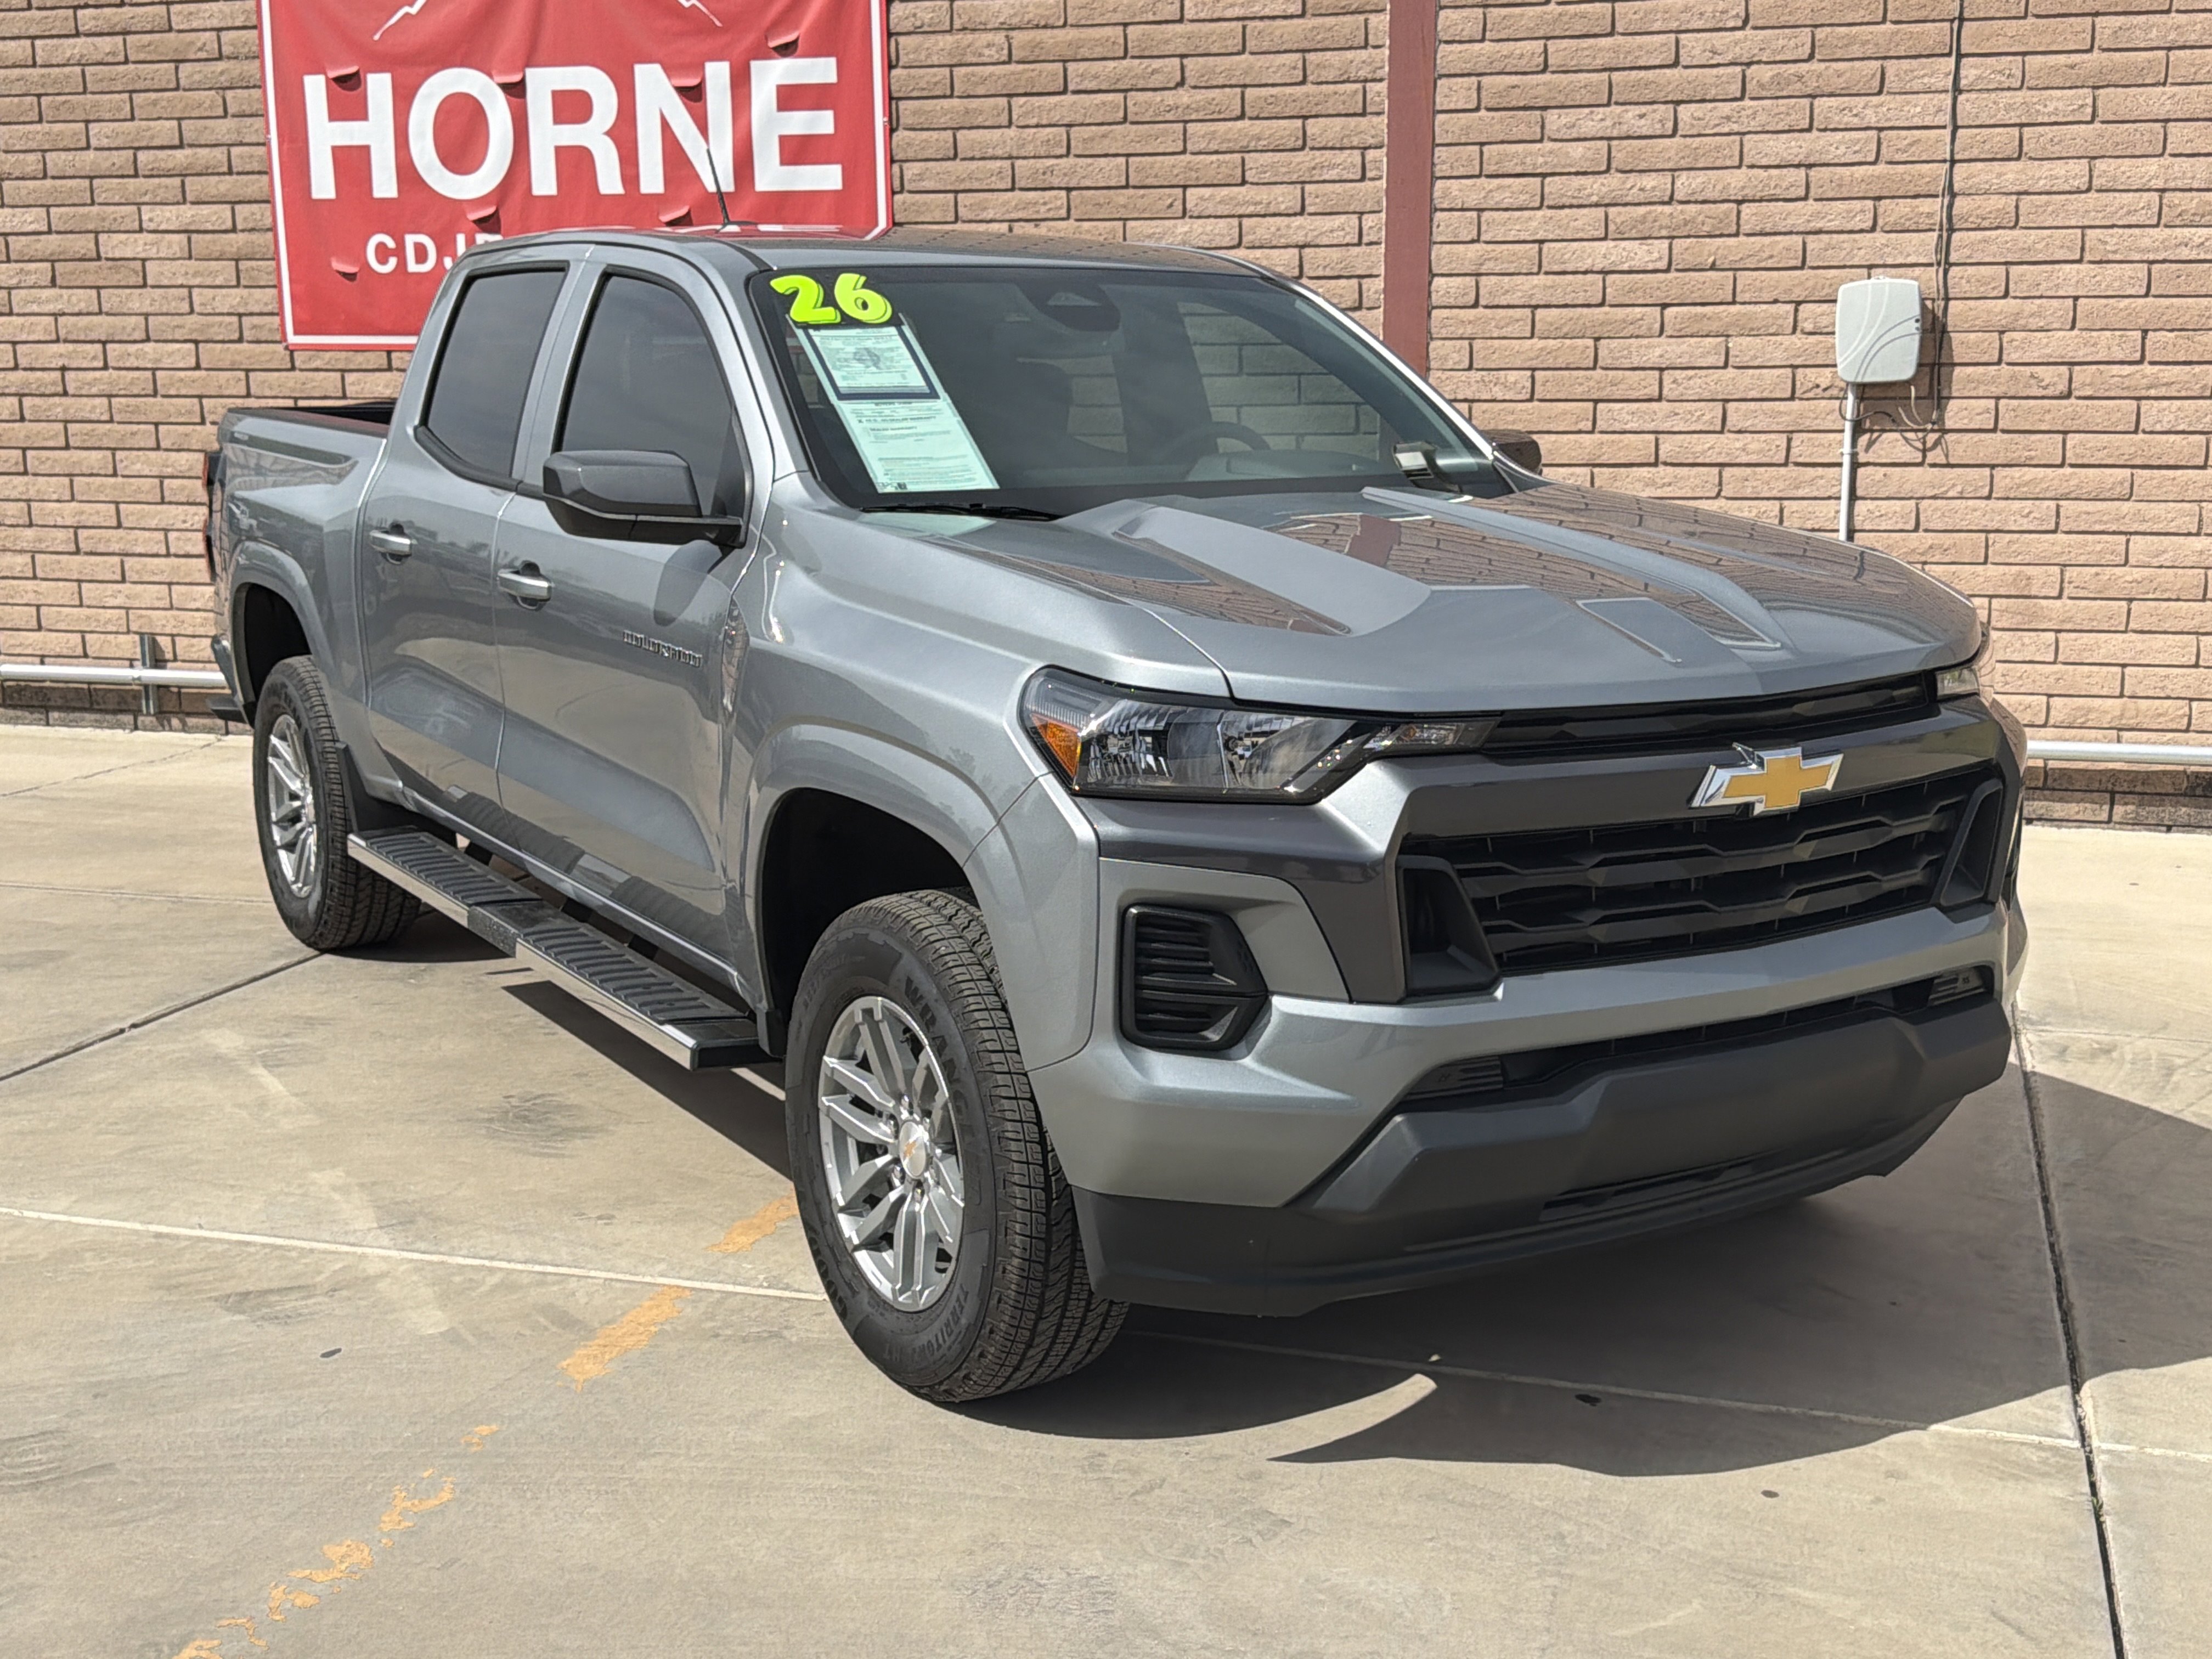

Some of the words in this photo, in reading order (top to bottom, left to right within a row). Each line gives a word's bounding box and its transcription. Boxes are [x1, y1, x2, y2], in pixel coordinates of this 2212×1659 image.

[303, 57, 843, 201] HORNE
[366, 232, 504, 273] CDJ
[769, 273, 893, 325] 26
